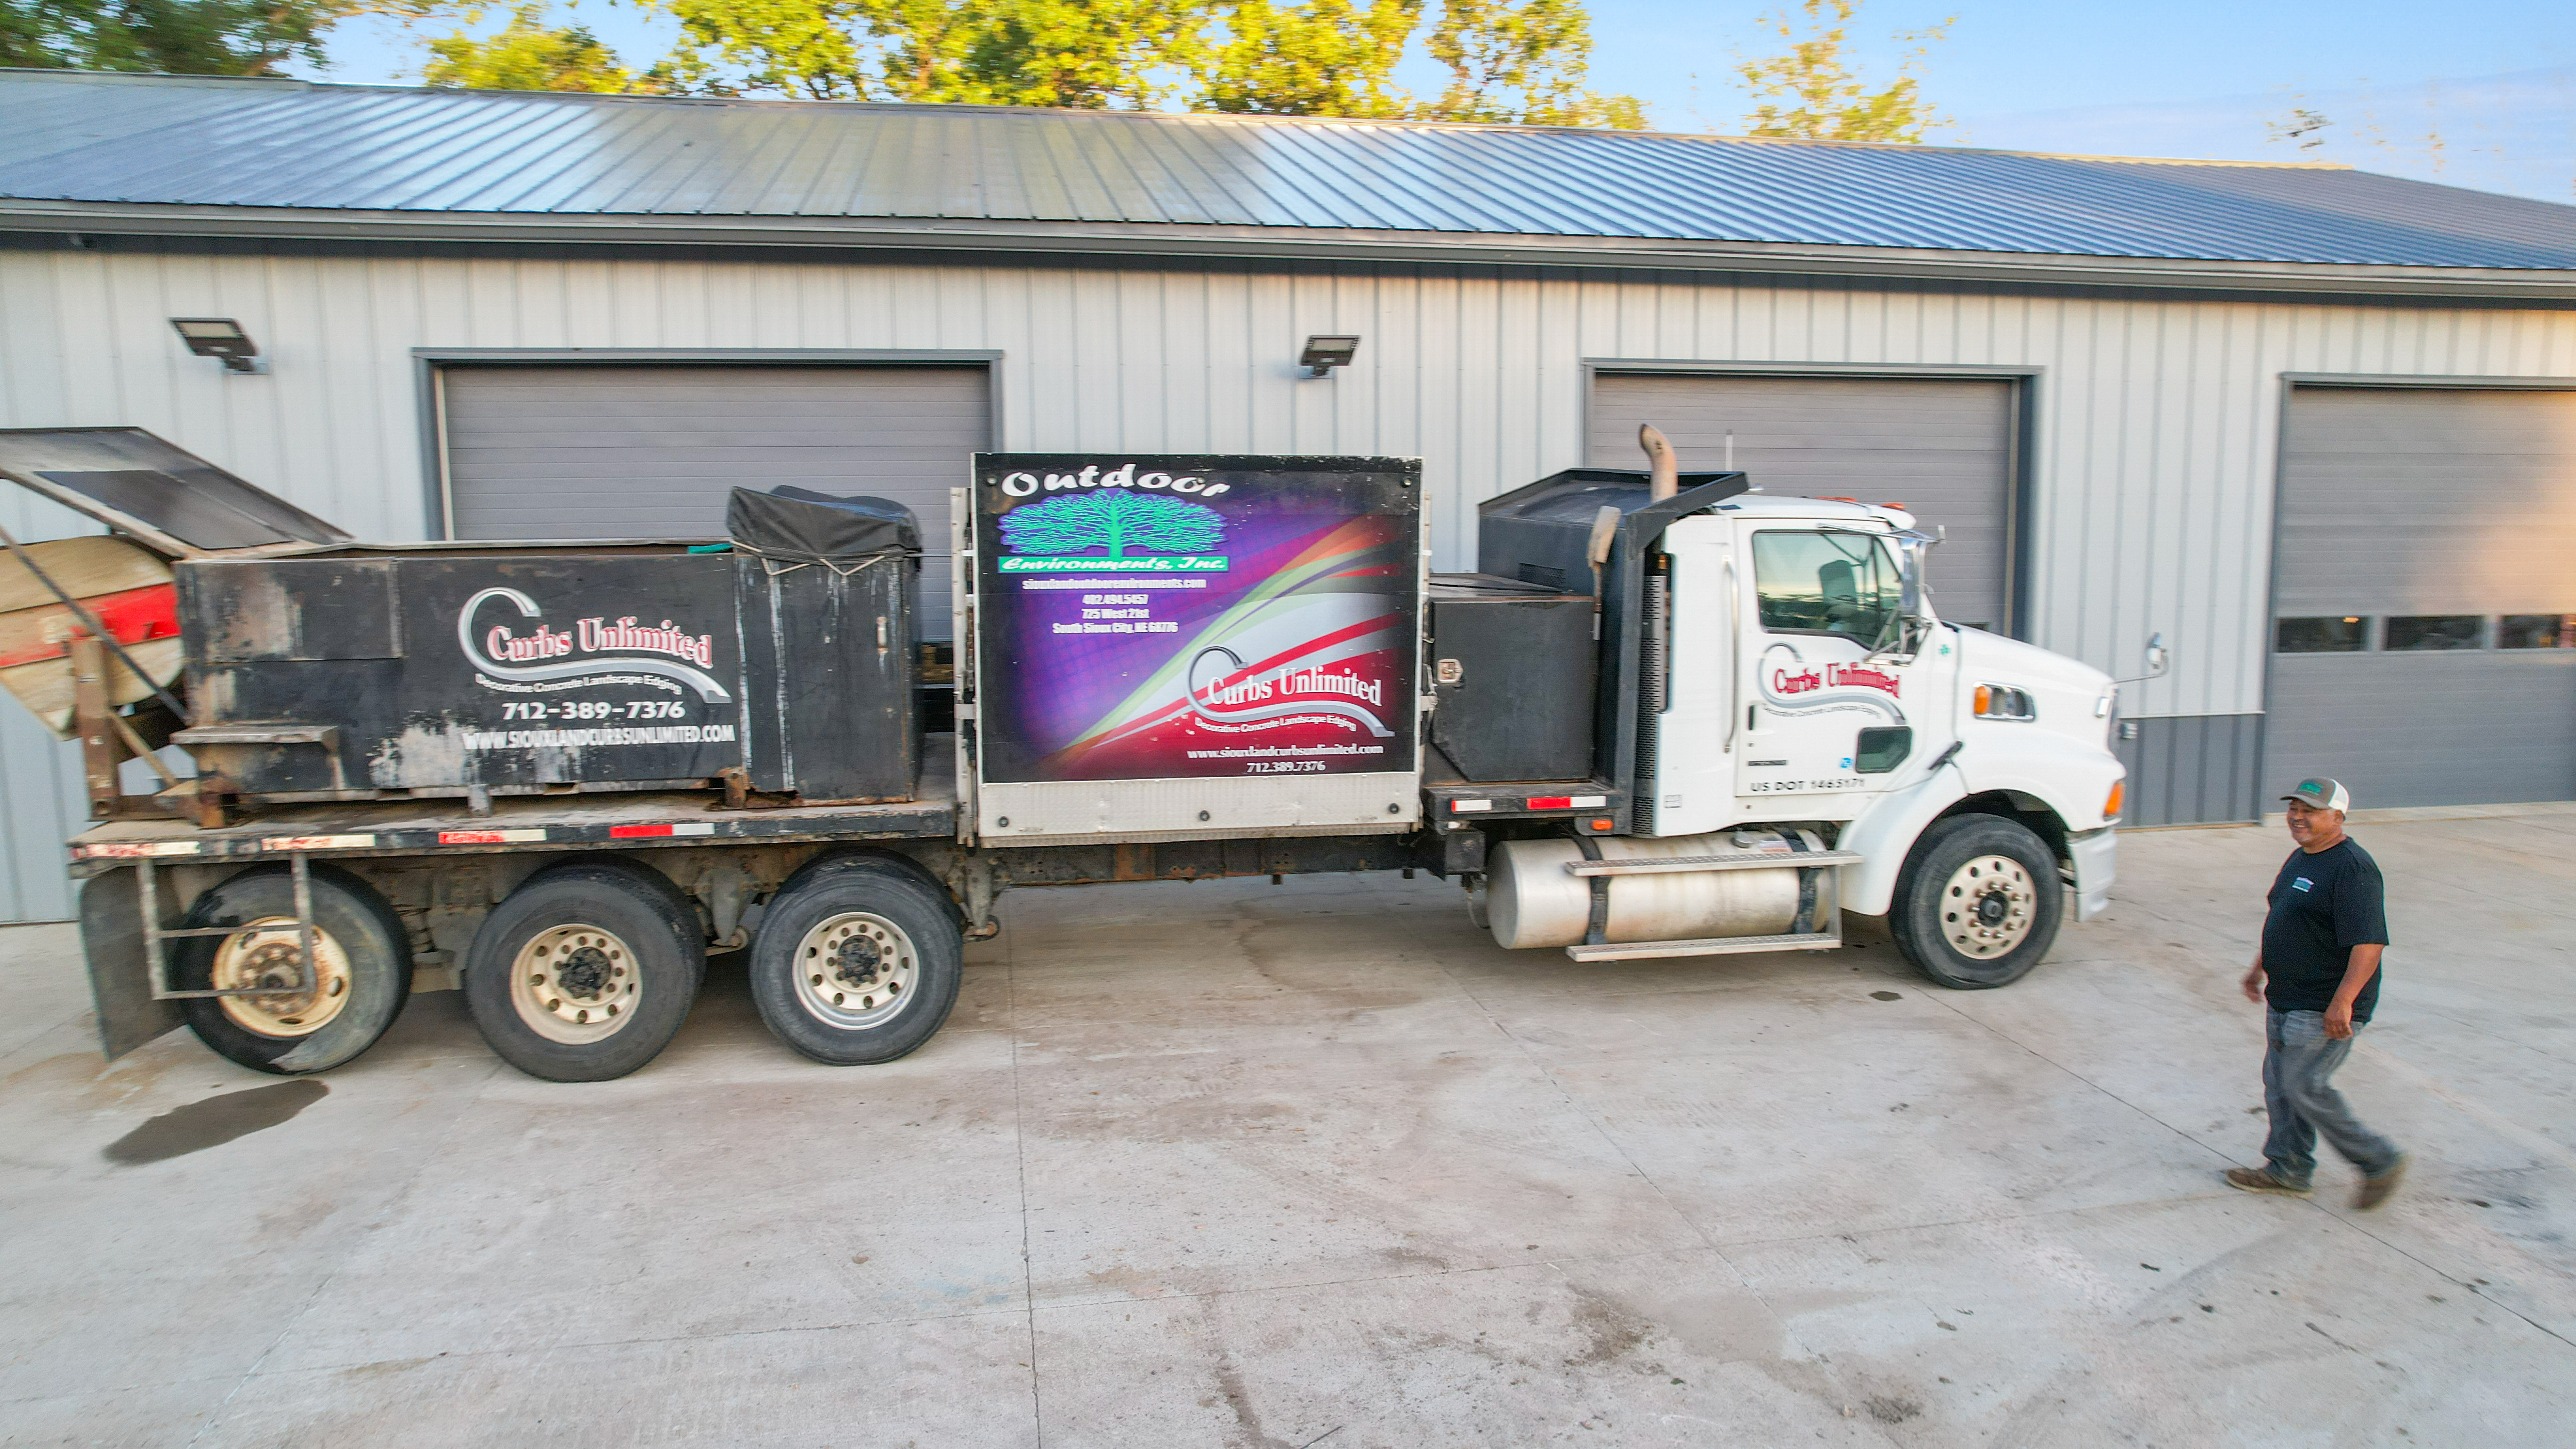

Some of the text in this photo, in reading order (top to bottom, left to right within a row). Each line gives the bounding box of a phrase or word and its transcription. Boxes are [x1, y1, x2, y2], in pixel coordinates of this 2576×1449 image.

[1002, 464, 1231, 497] Outdoor
[1002, 557, 1225, 570] Environments, Inc.
[1081, 609, 1150, 619] 725 West 21st
[1052, 622, 1179, 634] South Sioux City, NE 68776
[487, 616, 713, 669] Curbs Unlimited
[475, 673, 683, 695] Decorative Concrete Landscape Edging
[1208, 666, 1382, 706] Curbs Unlimited
[1774, 661, 1900, 699] Curbs Unlimited
[501, 701, 686, 720] 712-389-7376
[1195, 715, 1357, 733] Decorative Concrete Landscape Edging
[462, 725, 736, 750] WWW.SIOUXLANDCURBSUNLIMITED.COM
[1188, 744, 1384, 758] www.siouxlandcurbsunlimited.com
[1247, 761, 1326, 773] 712.389.7376
[1750, 782, 1770, 792] US
[1775, 781, 1805, 790] DOT
